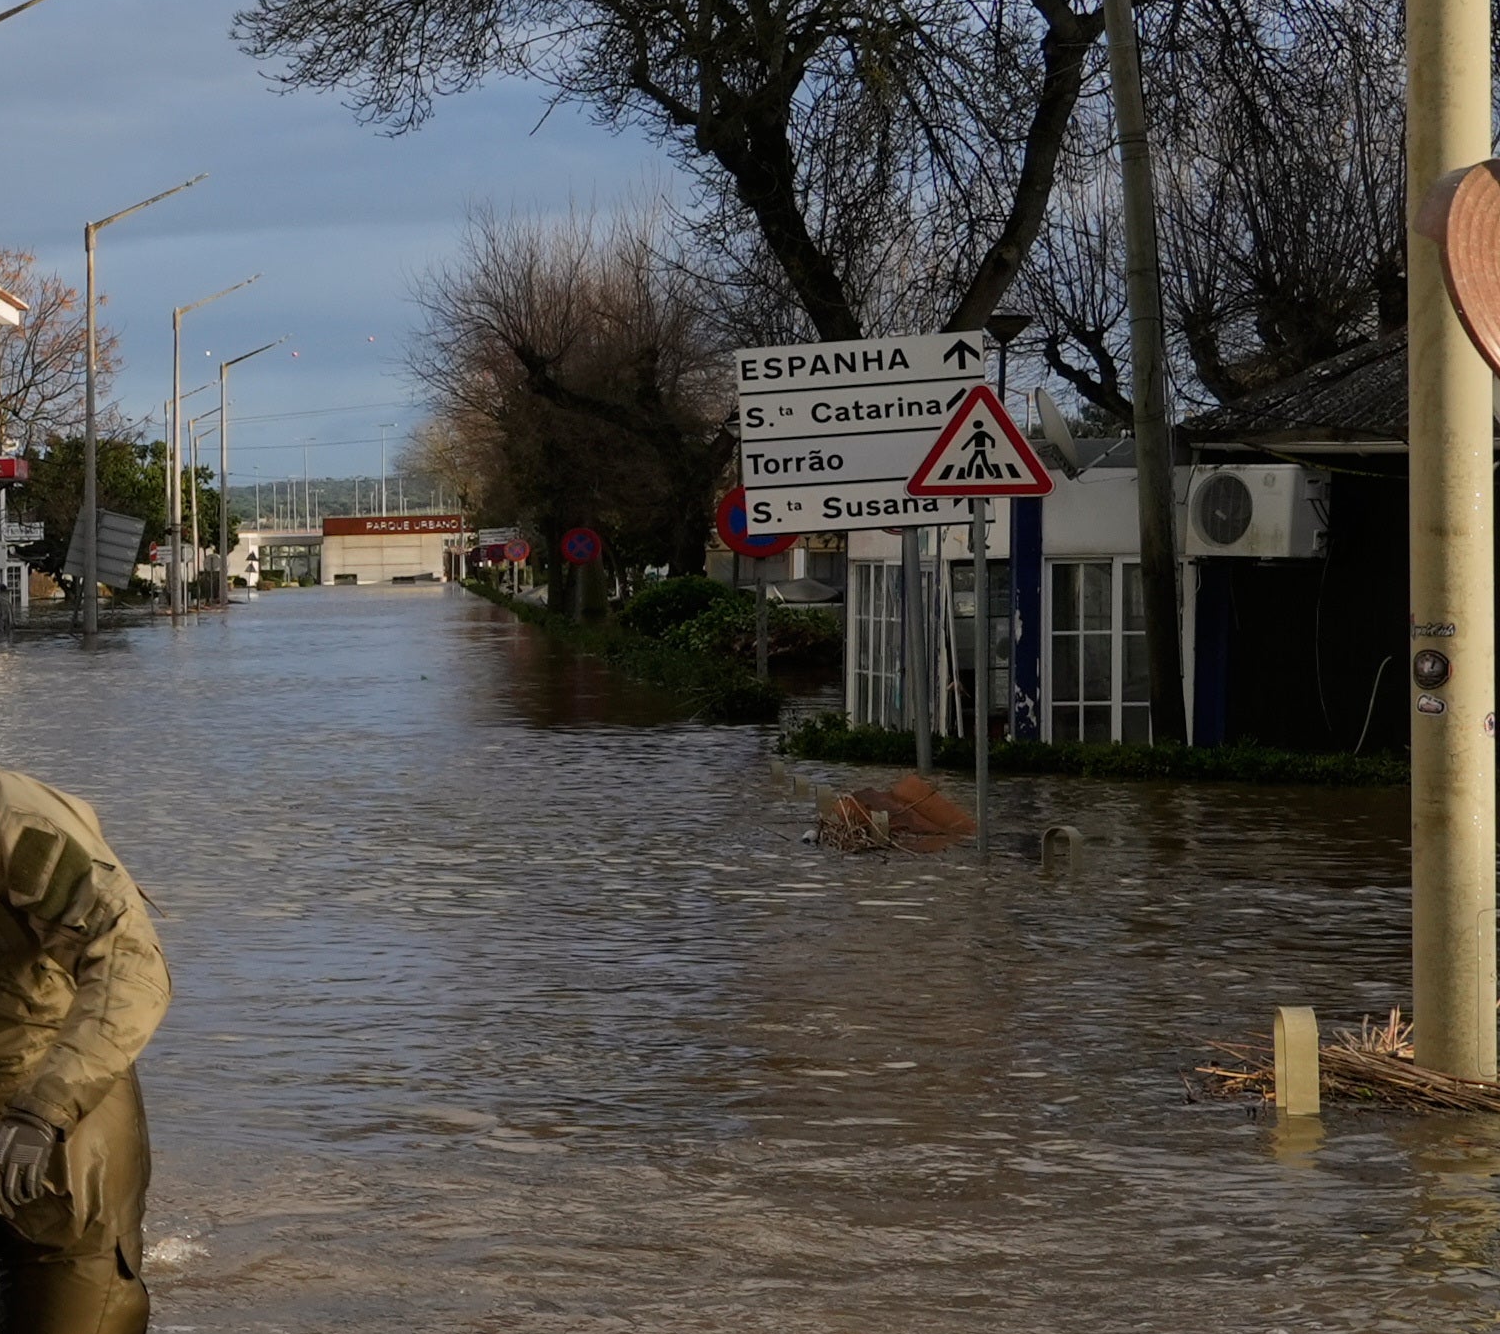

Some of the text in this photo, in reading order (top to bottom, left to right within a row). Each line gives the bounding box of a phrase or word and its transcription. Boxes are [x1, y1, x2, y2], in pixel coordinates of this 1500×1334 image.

[741, 348, 910, 381] ESPANHA
[811, 397, 942, 423] Catarina
[747, 450, 844, 475] Torrão
[823, 497, 939, 519] Susana
[366, 520, 410, 531] PARQUE
[413, 519, 459, 529] URBANO
